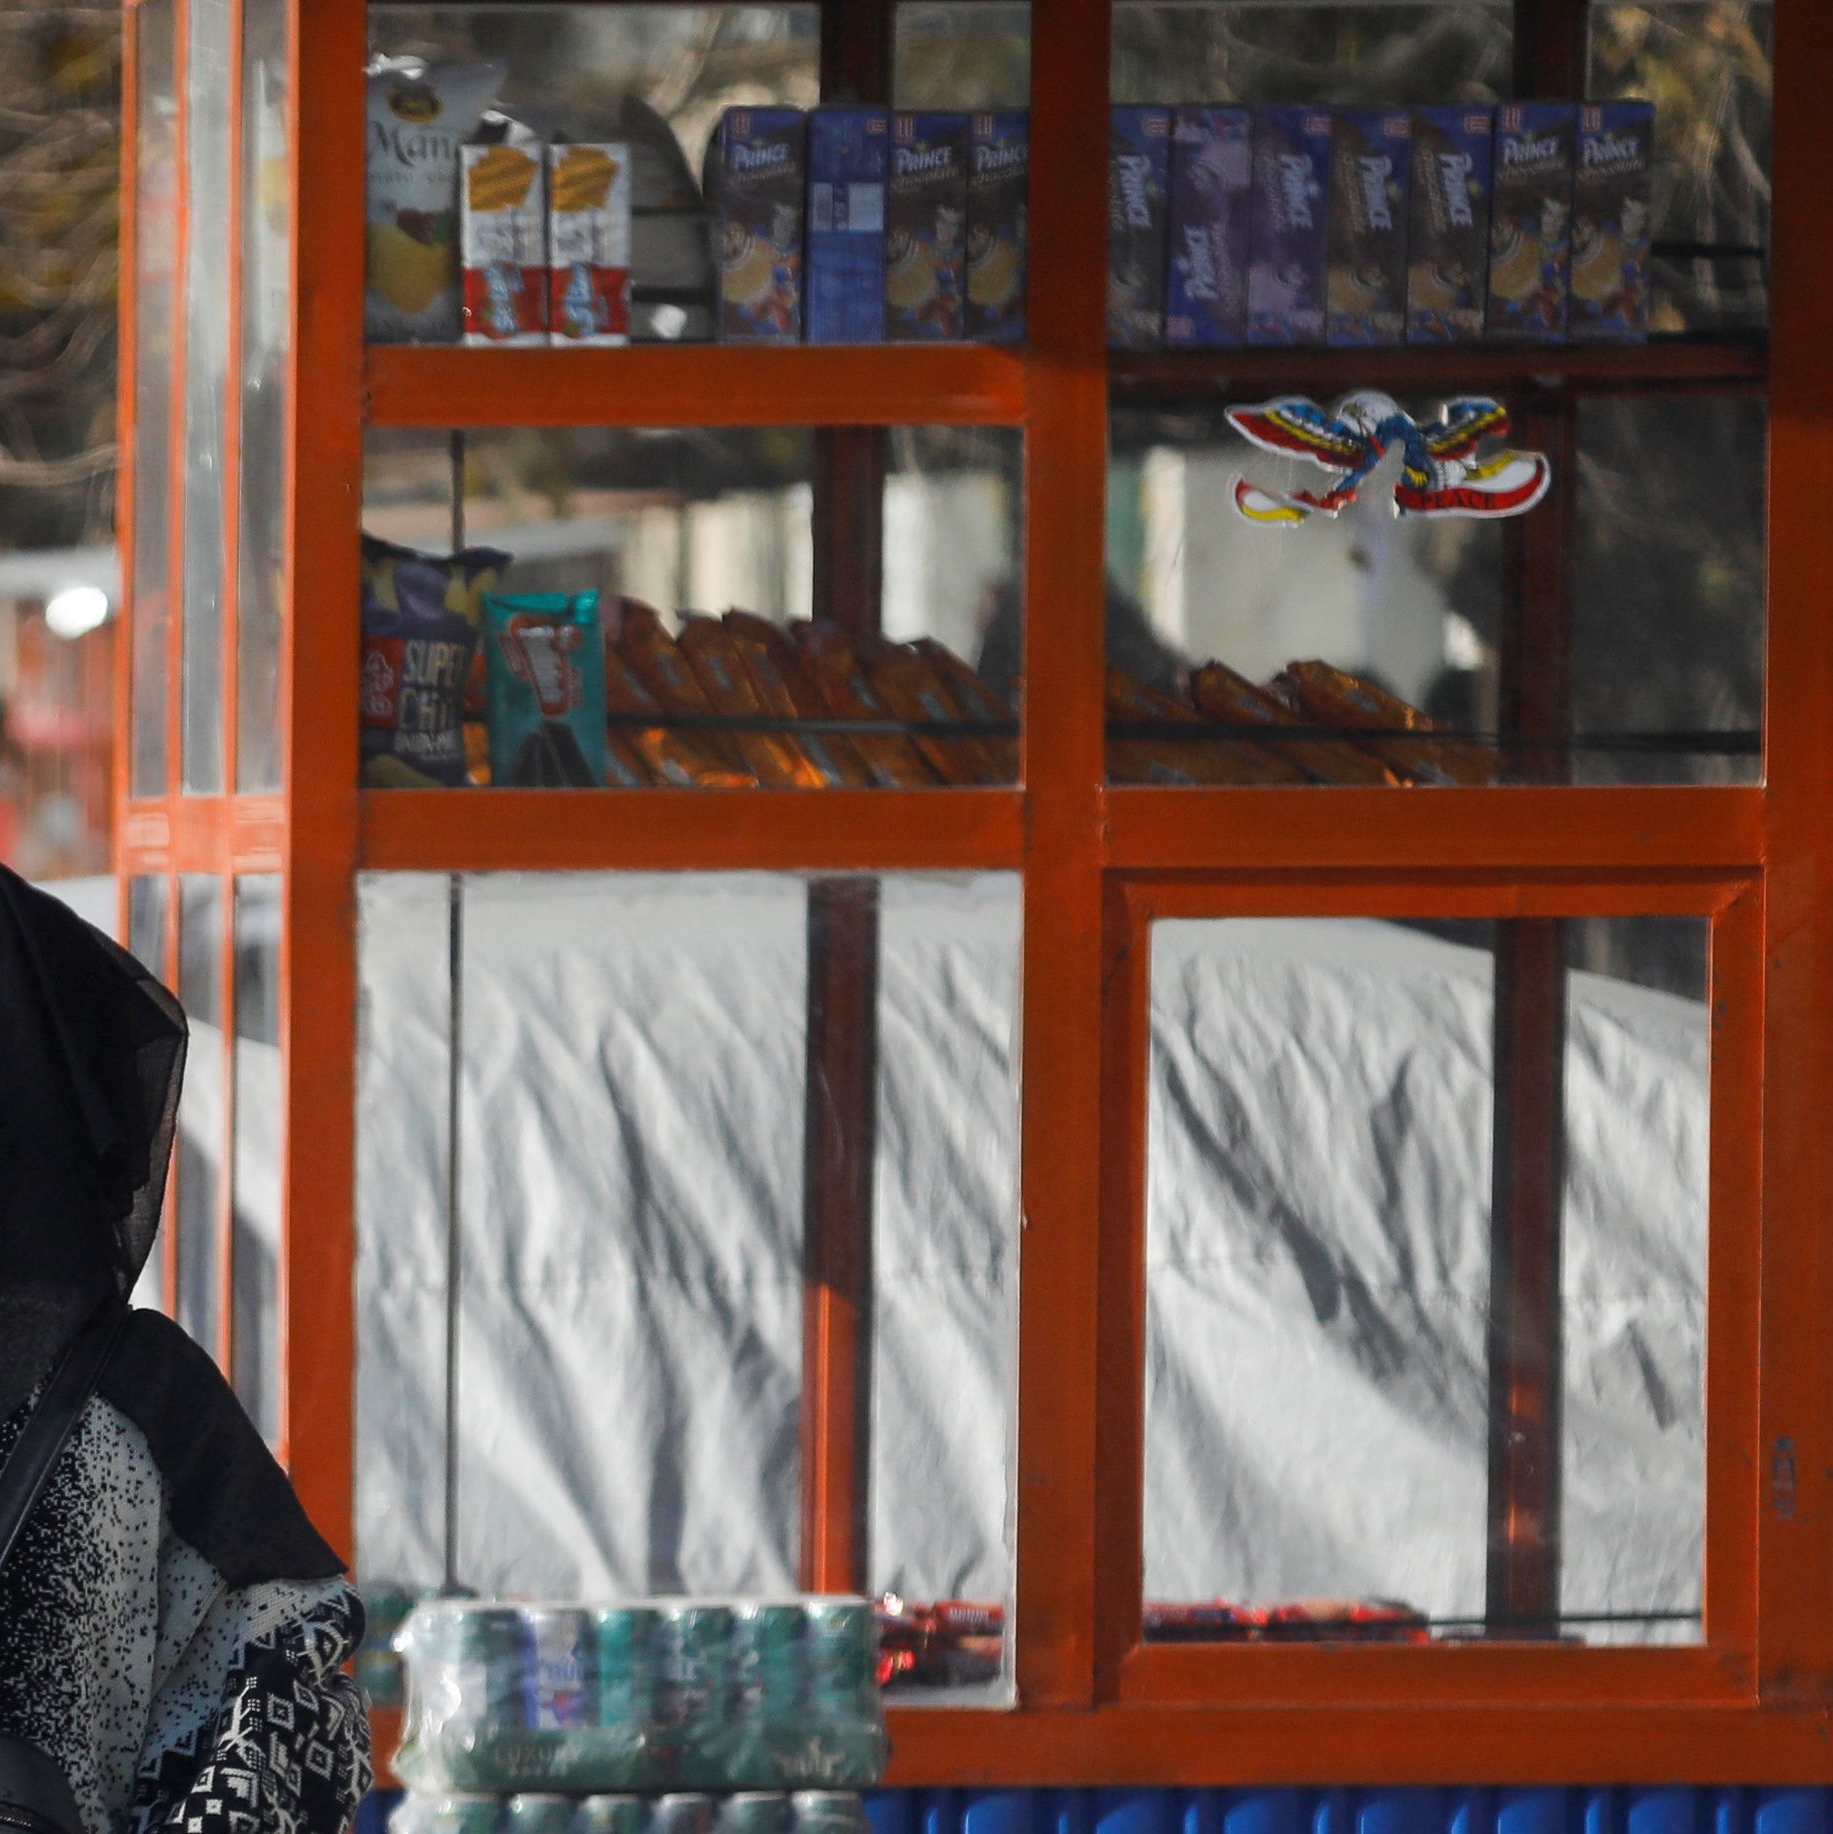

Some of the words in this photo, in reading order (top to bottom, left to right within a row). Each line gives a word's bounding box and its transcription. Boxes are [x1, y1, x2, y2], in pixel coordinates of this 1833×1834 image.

[733, 143, 790, 171] PRINCE
[893, 145, 953, 174] PRINCE
[976, 144, 1028, 173] PRINC
[1502, 135, 1561, 165] PRINCE
[1582, 135, 1639, 165] PRINCE
[1117, 155, 1152, 230] PRINCE
[1438, 152, 1474, 230] PRINCE
